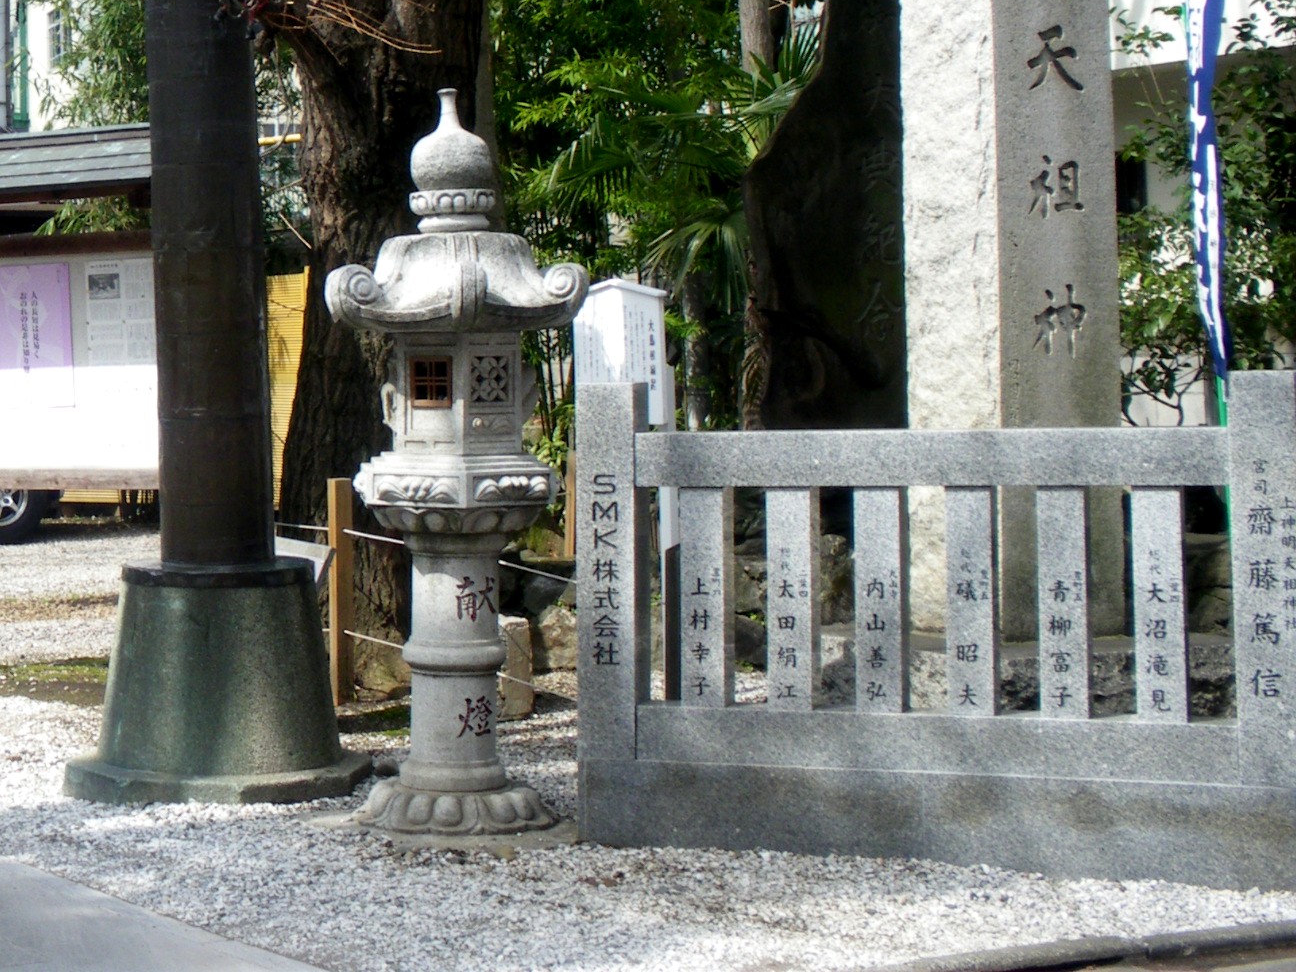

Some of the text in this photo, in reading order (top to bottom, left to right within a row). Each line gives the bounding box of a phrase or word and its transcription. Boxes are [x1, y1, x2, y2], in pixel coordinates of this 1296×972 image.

[1253, 459, 1268, 495] 宮司
[592, 474, 620, 667] SMK株式会社
[455, 576, 497, 738] 献燈
[690, 578, 711, 696] 上村幸子
[776, 579, 797, 699] 太田絹江
[866, 579, 887, 701] 内山善弘
[1049, 580, 1072, 709] 青柳富子
[1145, 582, 1171, 712] 大沼滝見
